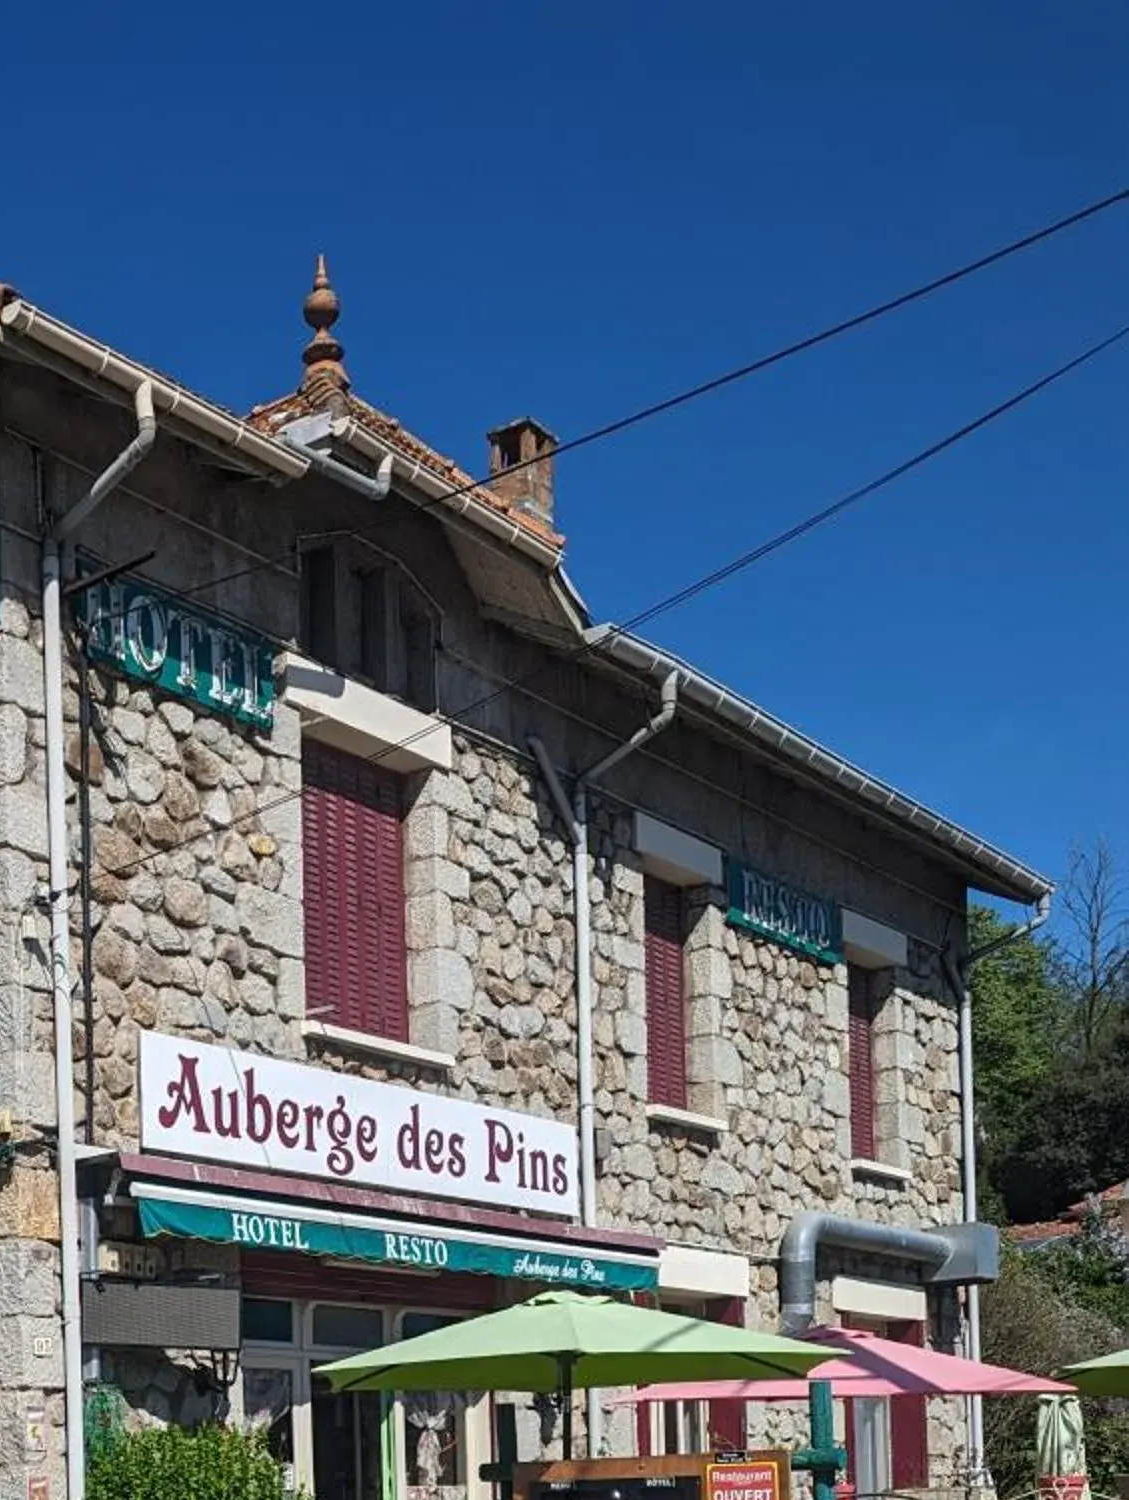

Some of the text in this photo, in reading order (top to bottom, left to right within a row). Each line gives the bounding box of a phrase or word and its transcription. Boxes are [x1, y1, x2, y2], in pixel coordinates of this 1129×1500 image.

[82, 574, 276, 722] HOTEL
[158, 1053, 569, 1196] Auberge des Pins
[231, 1213, 310, 1250] HOTEL
[384, 1234, 449, 1265] RESTO
[513, 1253, 606, 1282] Auberge des Pins
